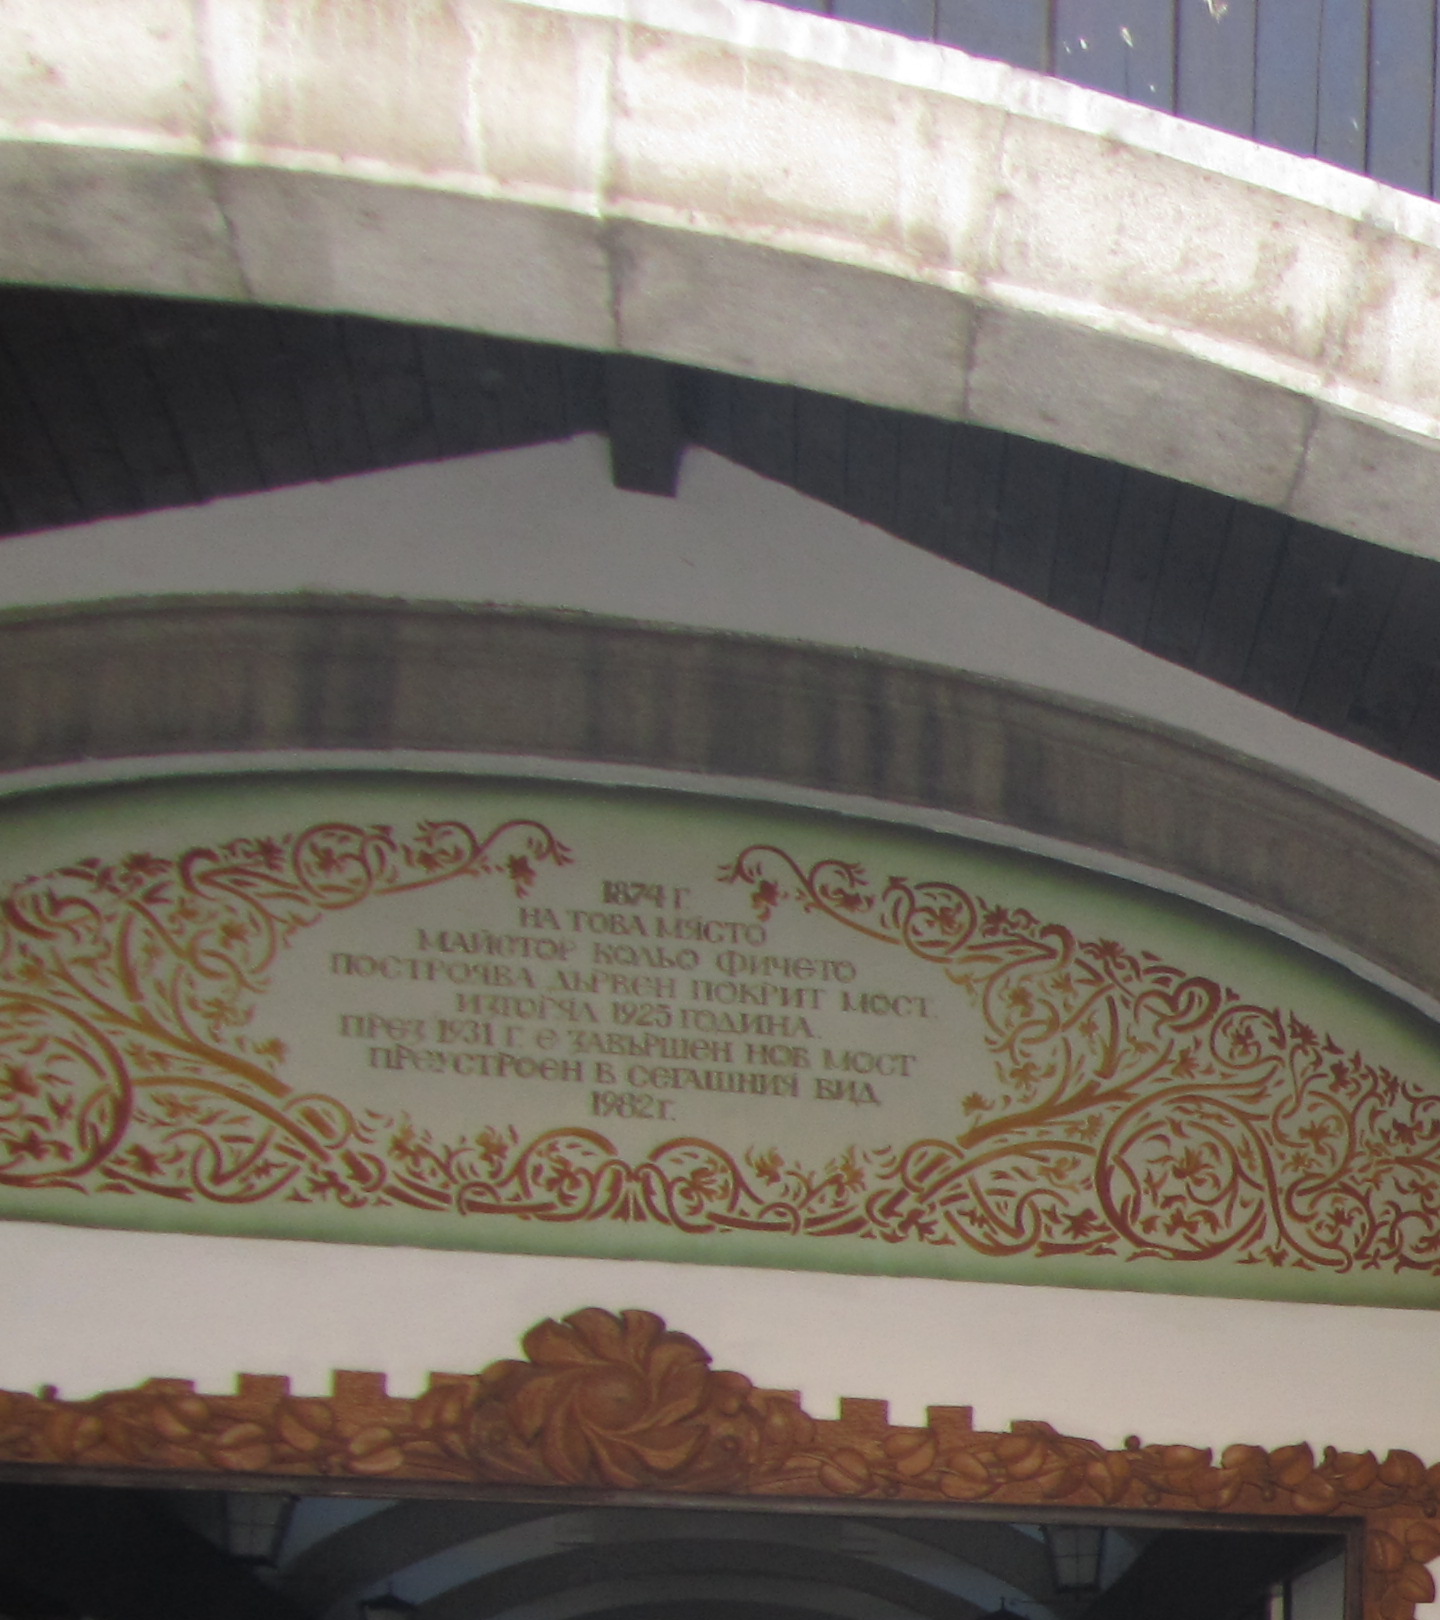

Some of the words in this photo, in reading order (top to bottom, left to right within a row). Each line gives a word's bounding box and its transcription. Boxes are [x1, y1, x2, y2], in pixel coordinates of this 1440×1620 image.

[602, 880, 665, 909] 1874
[518, 906, 561, 931] НА
[565, 909, 650, 936] ТОВА
[655, 916, 767, 946] МЯСТО
[331, 952, 536, 989] ПОСТРОЯВА
[549, 970, 676, 999] ДЪРВЕН
[692, 979, 826, 1010] ПОКРИТ
[416, 928, 576, 962] МАЙСТОР
[593, 941, 700, 971] КОЛЬО
[716, 950, 857, 984] ФИЧЕТО
[455, 993, 600, 1023] ИЗГОРЯЛ
[612, 1001, 674, 1029] 1925
[338, 1014, 426, 1042] ПРЕЗ
[437, 1018, 495, 1047] 1931
[565, 1030, 733, 1064] ЗАВЪРШЕН
[745, 1043, 811, 1070] НОВ
[821, 1048, 918, 1078] МОСТ
[368, 1045, 584, 1083] ПРЕУСТРОЕН
[627, 1065, 800, 1098] СЕГАШНИЯ
[814, 1078, 882, 1107] ВИД
